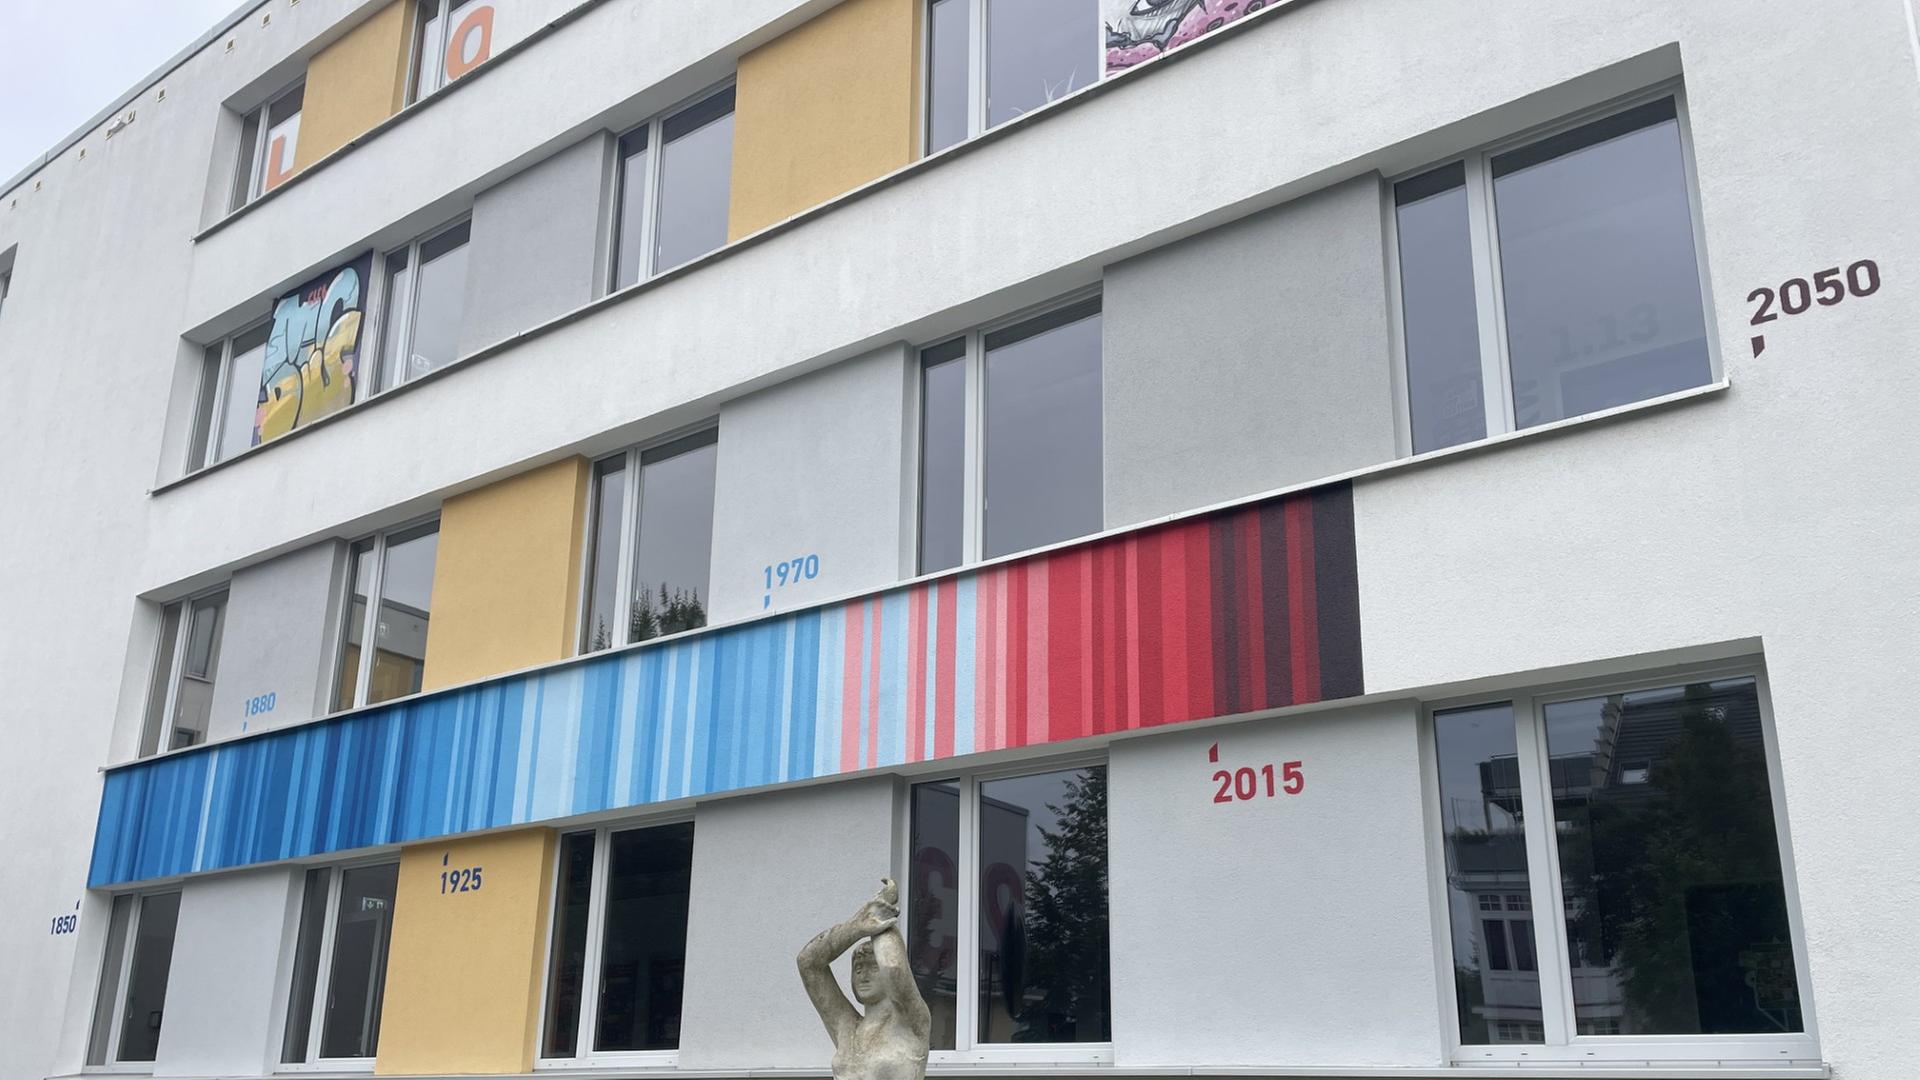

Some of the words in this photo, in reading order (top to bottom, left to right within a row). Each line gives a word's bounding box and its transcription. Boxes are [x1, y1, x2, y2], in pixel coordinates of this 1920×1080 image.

[1747, 259, 1881, 326] 2050
[764, 554, 819, 589] 1970
[245, 692, 276, 717] 1880
[1212, 761, 1304, 804] 2015
[441, 867, 482, 894] 1925
[51, 914, 77, 935] 1850
